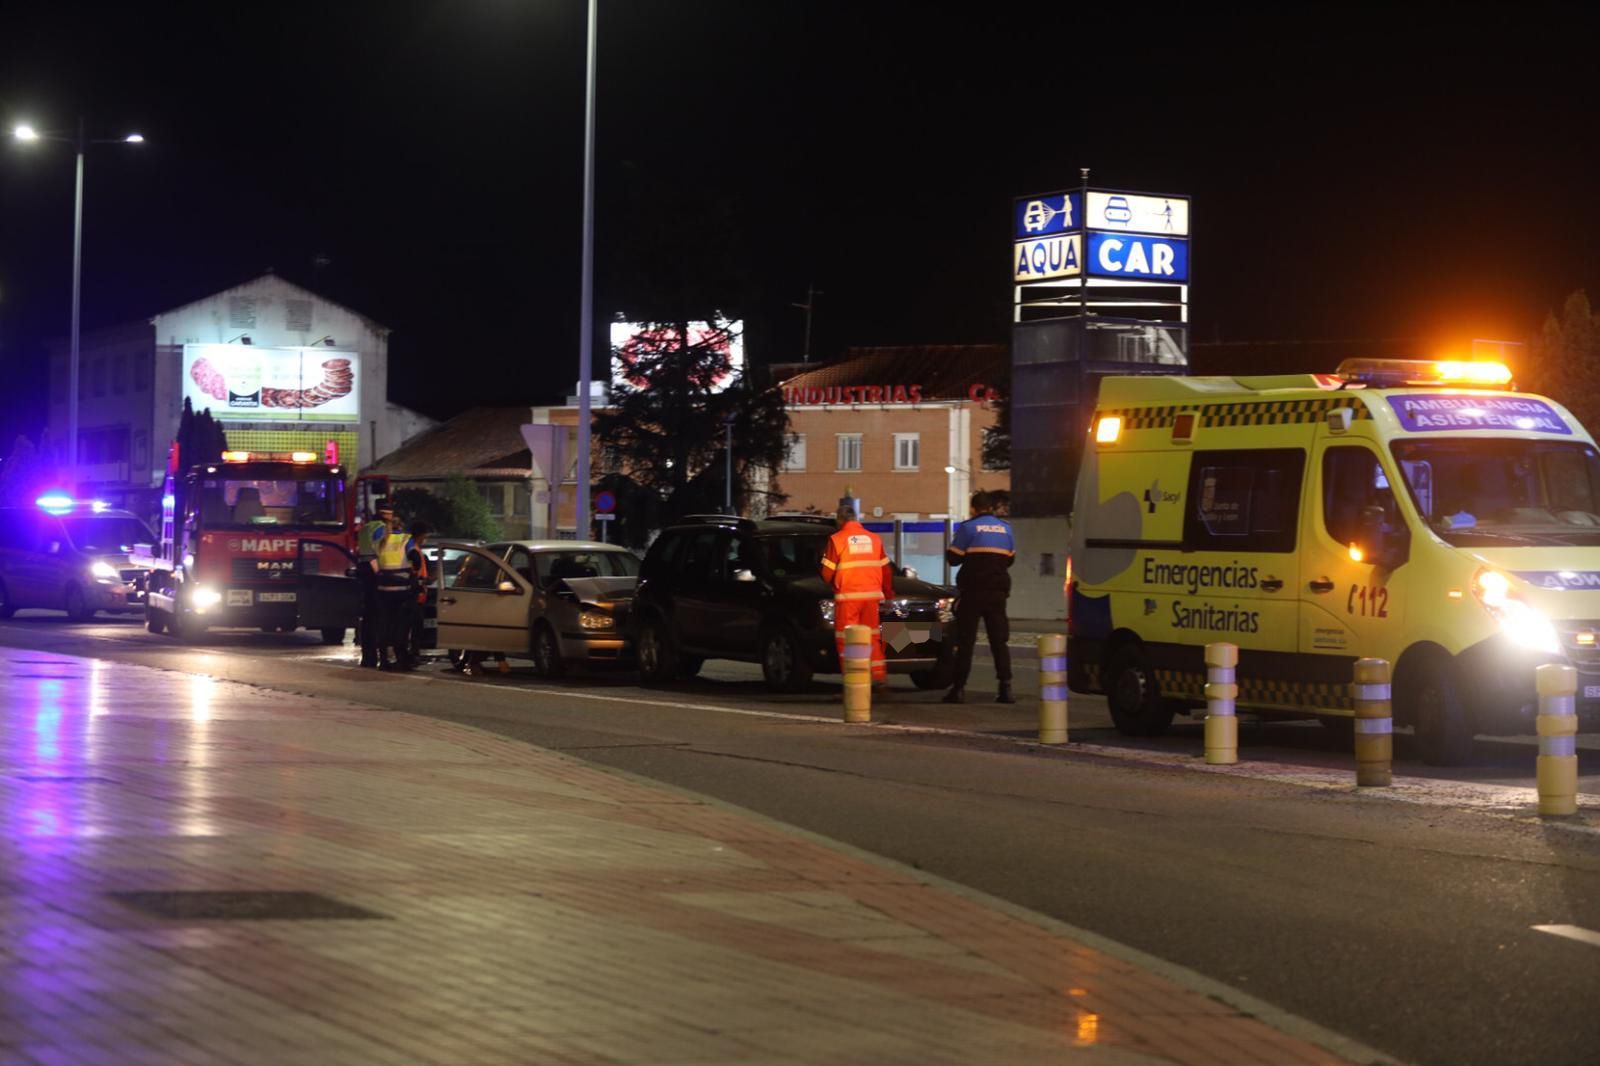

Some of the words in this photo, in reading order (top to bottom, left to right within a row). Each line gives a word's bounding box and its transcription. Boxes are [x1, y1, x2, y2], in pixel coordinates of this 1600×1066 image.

[1016, 239, 1079, 275] AQUA
[1098, 238, 1175, 276] CAR
[784, 384, 922, 405] INDUSTRIAS
[1404, 398, 1550, 415] AMBULANCIA
[1416, 413, 1562, 430] ASISTENAL
[257, 562, 294, 570] MAN
[1143, 557, 1259, 595] Emergencias
[1359, 585, 1389, 618] 112
[1171, 600, 1260, 633] Sanitarias
